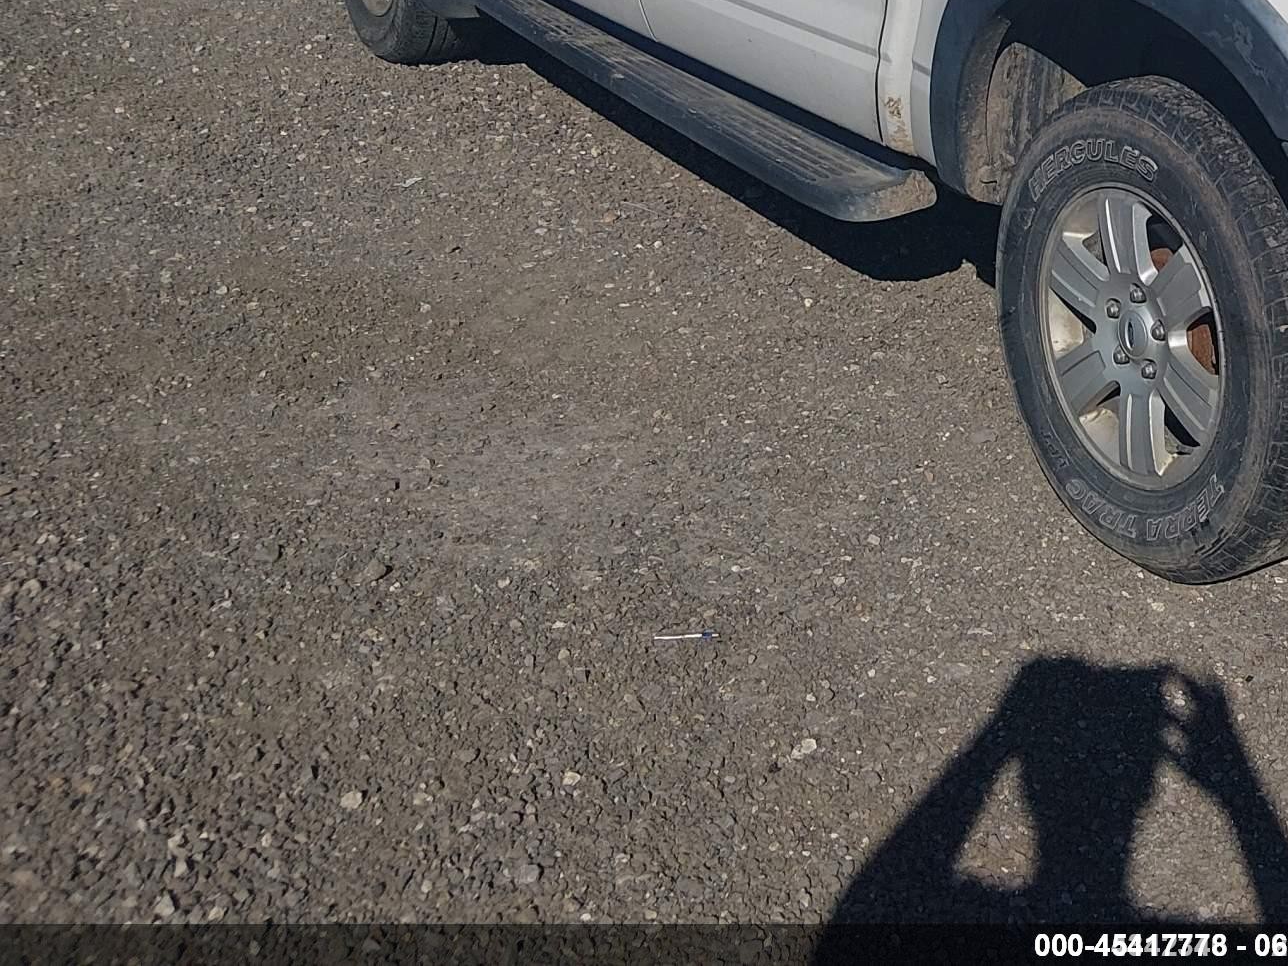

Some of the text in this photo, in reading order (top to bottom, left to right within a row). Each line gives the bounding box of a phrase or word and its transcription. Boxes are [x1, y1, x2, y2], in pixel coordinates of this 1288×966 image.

[1028, 138, 1159, 202] HERCULES
[1065, 478, 1138, 539] TRAC
[1146, 473, 1225, 541] TERRA
